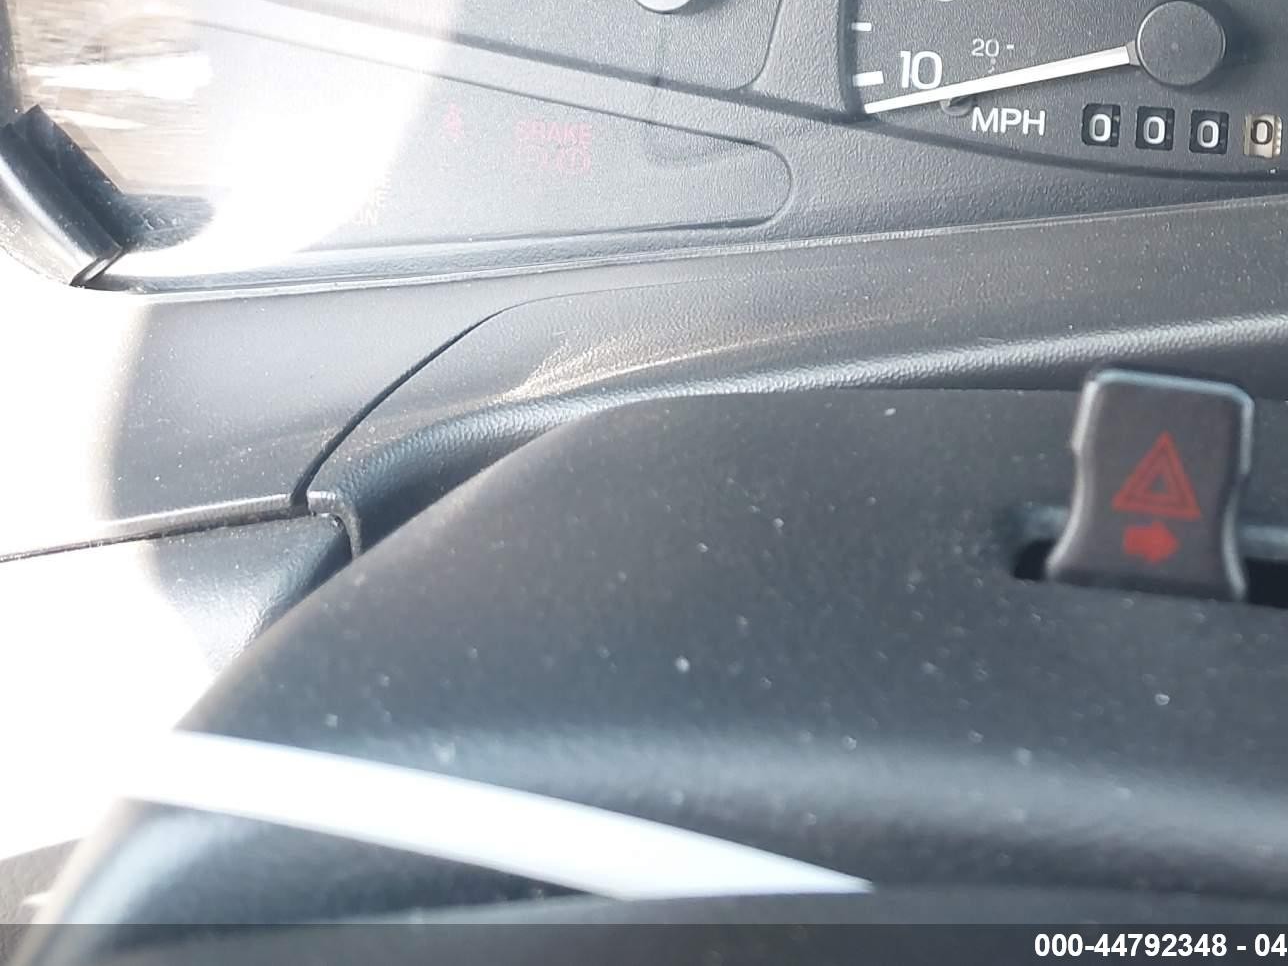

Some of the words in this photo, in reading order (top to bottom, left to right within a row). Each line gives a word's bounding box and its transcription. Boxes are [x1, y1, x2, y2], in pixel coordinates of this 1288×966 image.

[972, 38, 999, 57] 20
[900, 51, 943, 90] 10
[972, 107, 1045, 135] MPH
